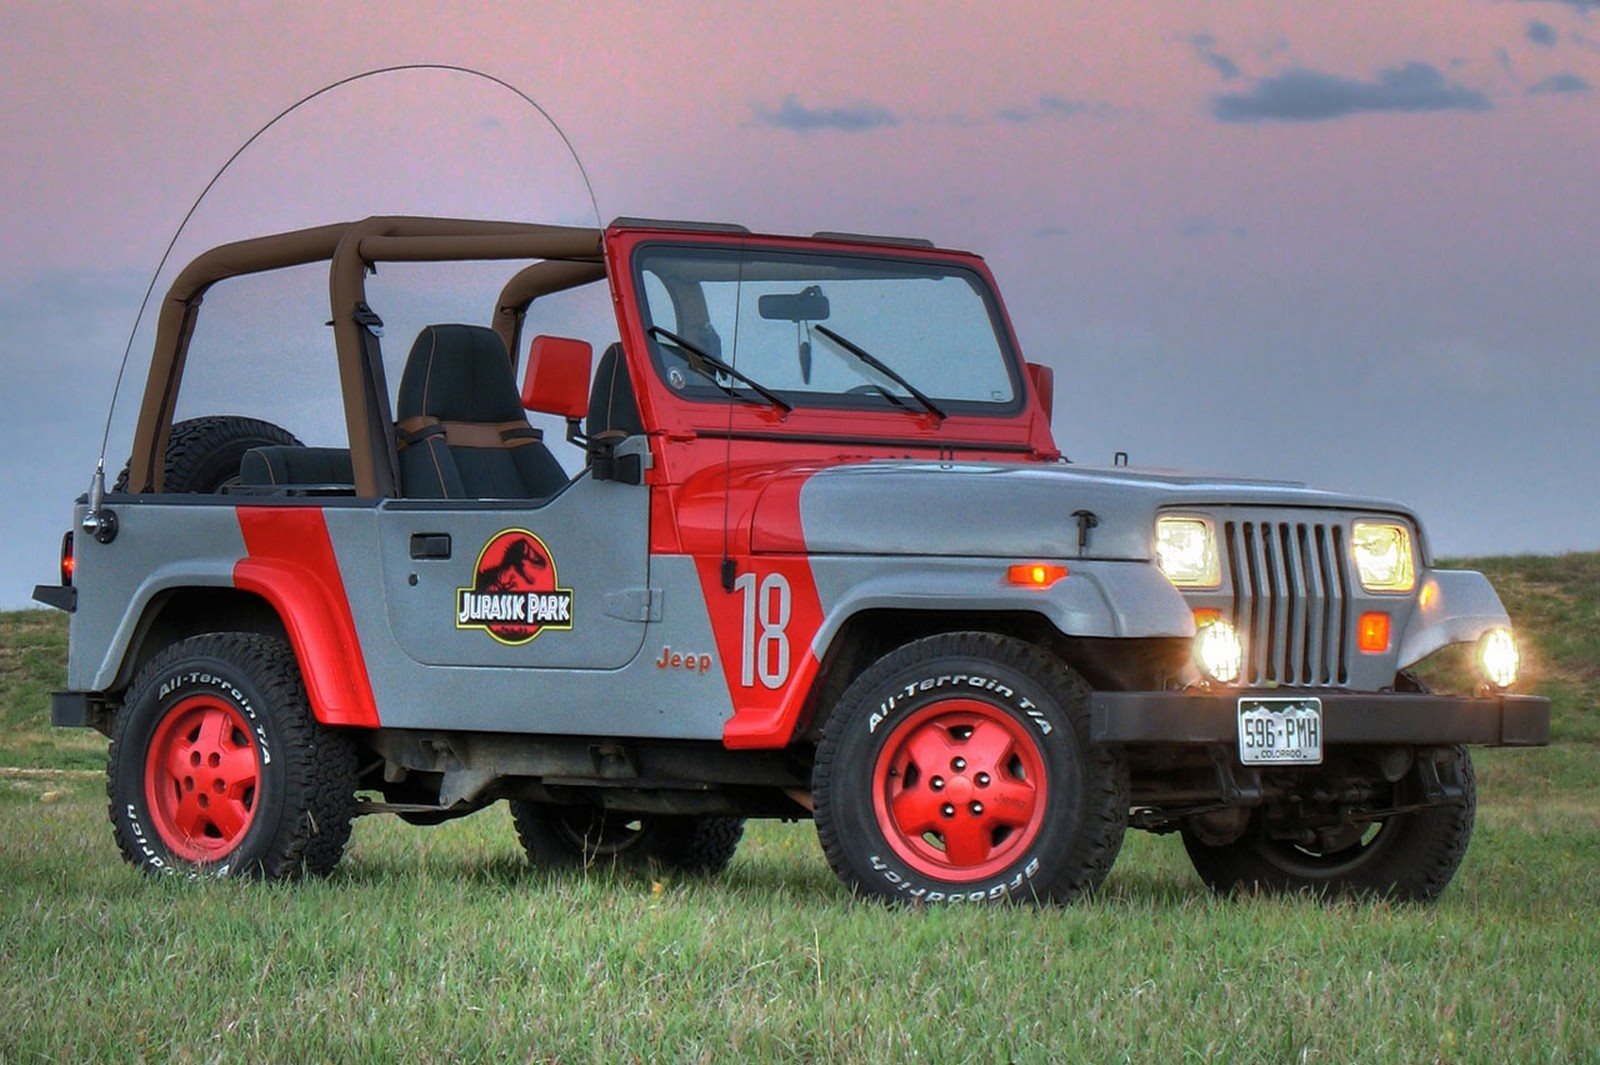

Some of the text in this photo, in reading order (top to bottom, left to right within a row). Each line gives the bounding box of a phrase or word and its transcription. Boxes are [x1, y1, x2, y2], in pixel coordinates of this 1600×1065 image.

[527, 593, 571, 624] PARK
[734, 572, 792, 689] 18
[656, 645, 712, 675] Jeep
[158, 672, 271, 765] All-Terrain T/A
[868, 674, 1053, 737] All-Terrain T/A
[870, 856, 1040, 901] BFGoodrich
